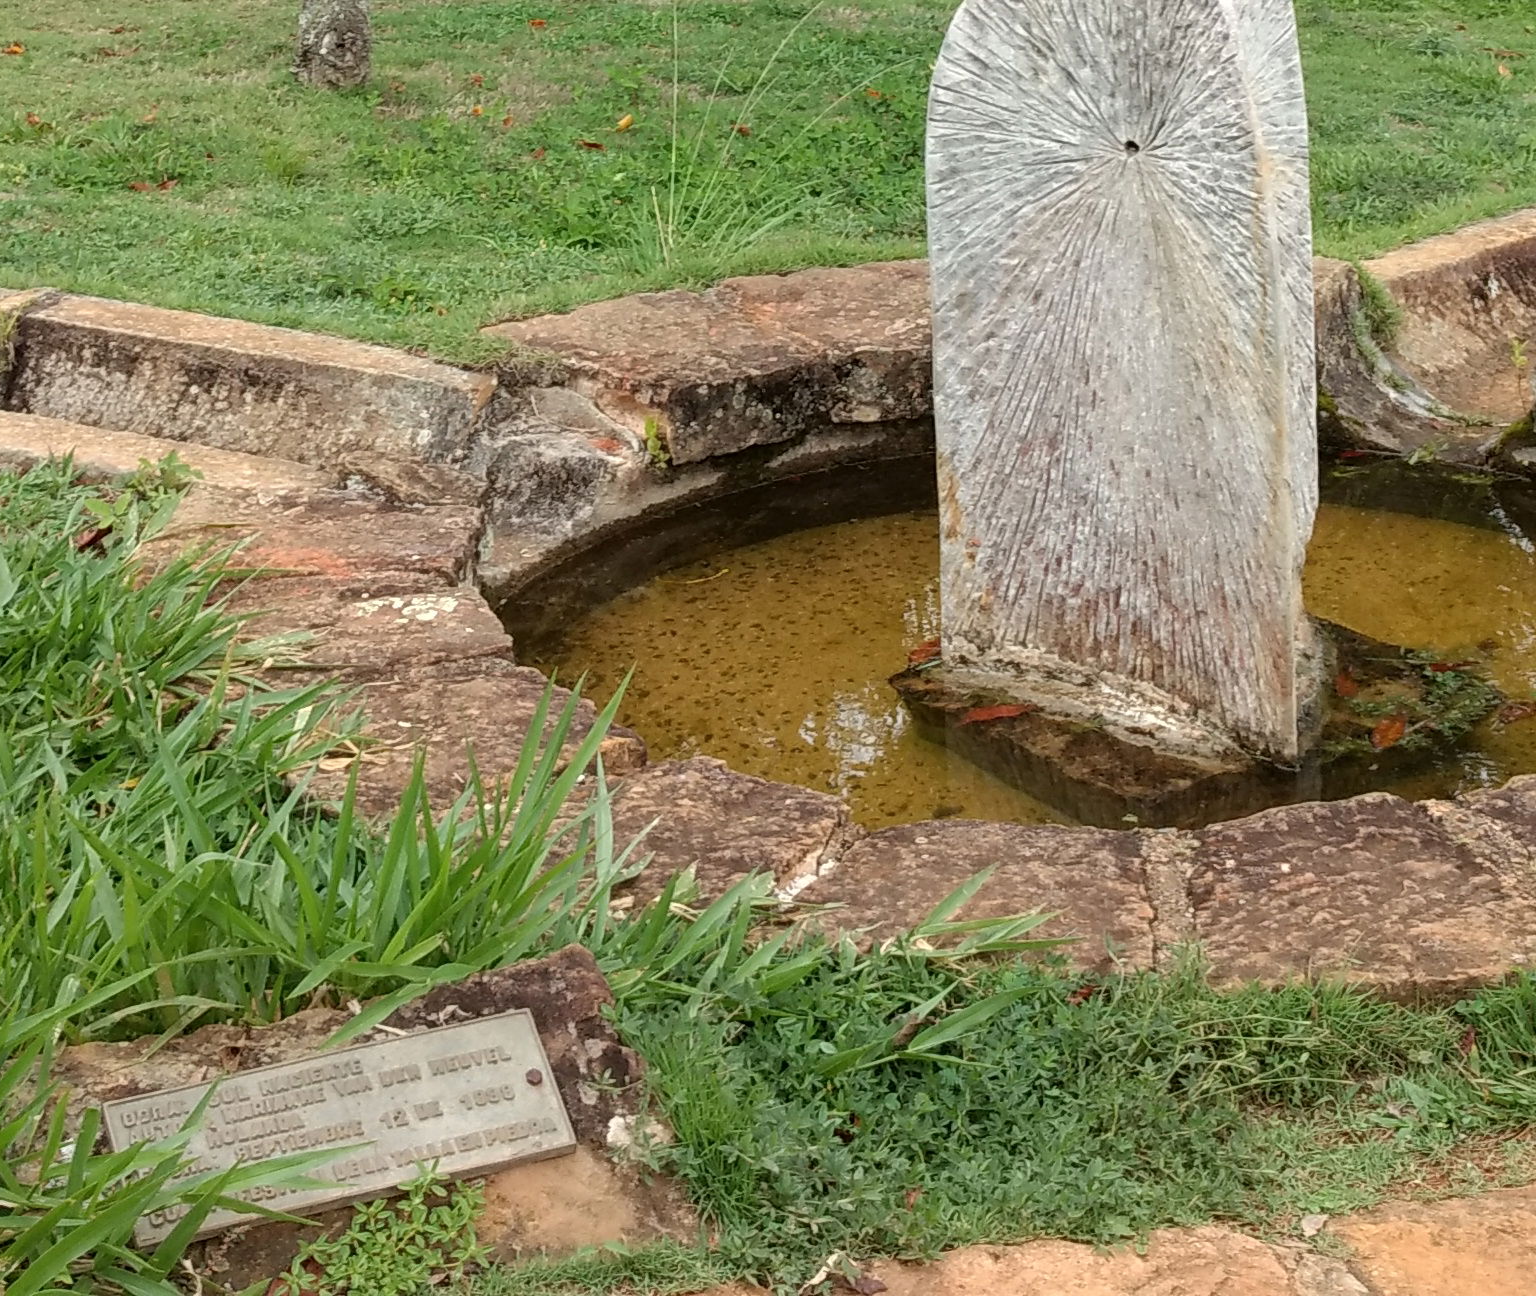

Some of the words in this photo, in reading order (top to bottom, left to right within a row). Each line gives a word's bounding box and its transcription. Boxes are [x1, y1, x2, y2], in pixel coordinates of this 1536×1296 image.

[206, 1085, 249, 1107] SOL
[259, 1060, 363, 1096] NACIENTE
[333, 1077, 373, 1098] VAN
[379, 1066, 422, 1088] DEN
[206, 1114, 305, 1149] HOLANDA
[234, 1121, 364, 1163] SEPTIEMBRE
[378, 1109, 409, 1130] 12
[415, 1101, 443, 1120] DE
[484, 1117, 557, 1146] PIEDRA
